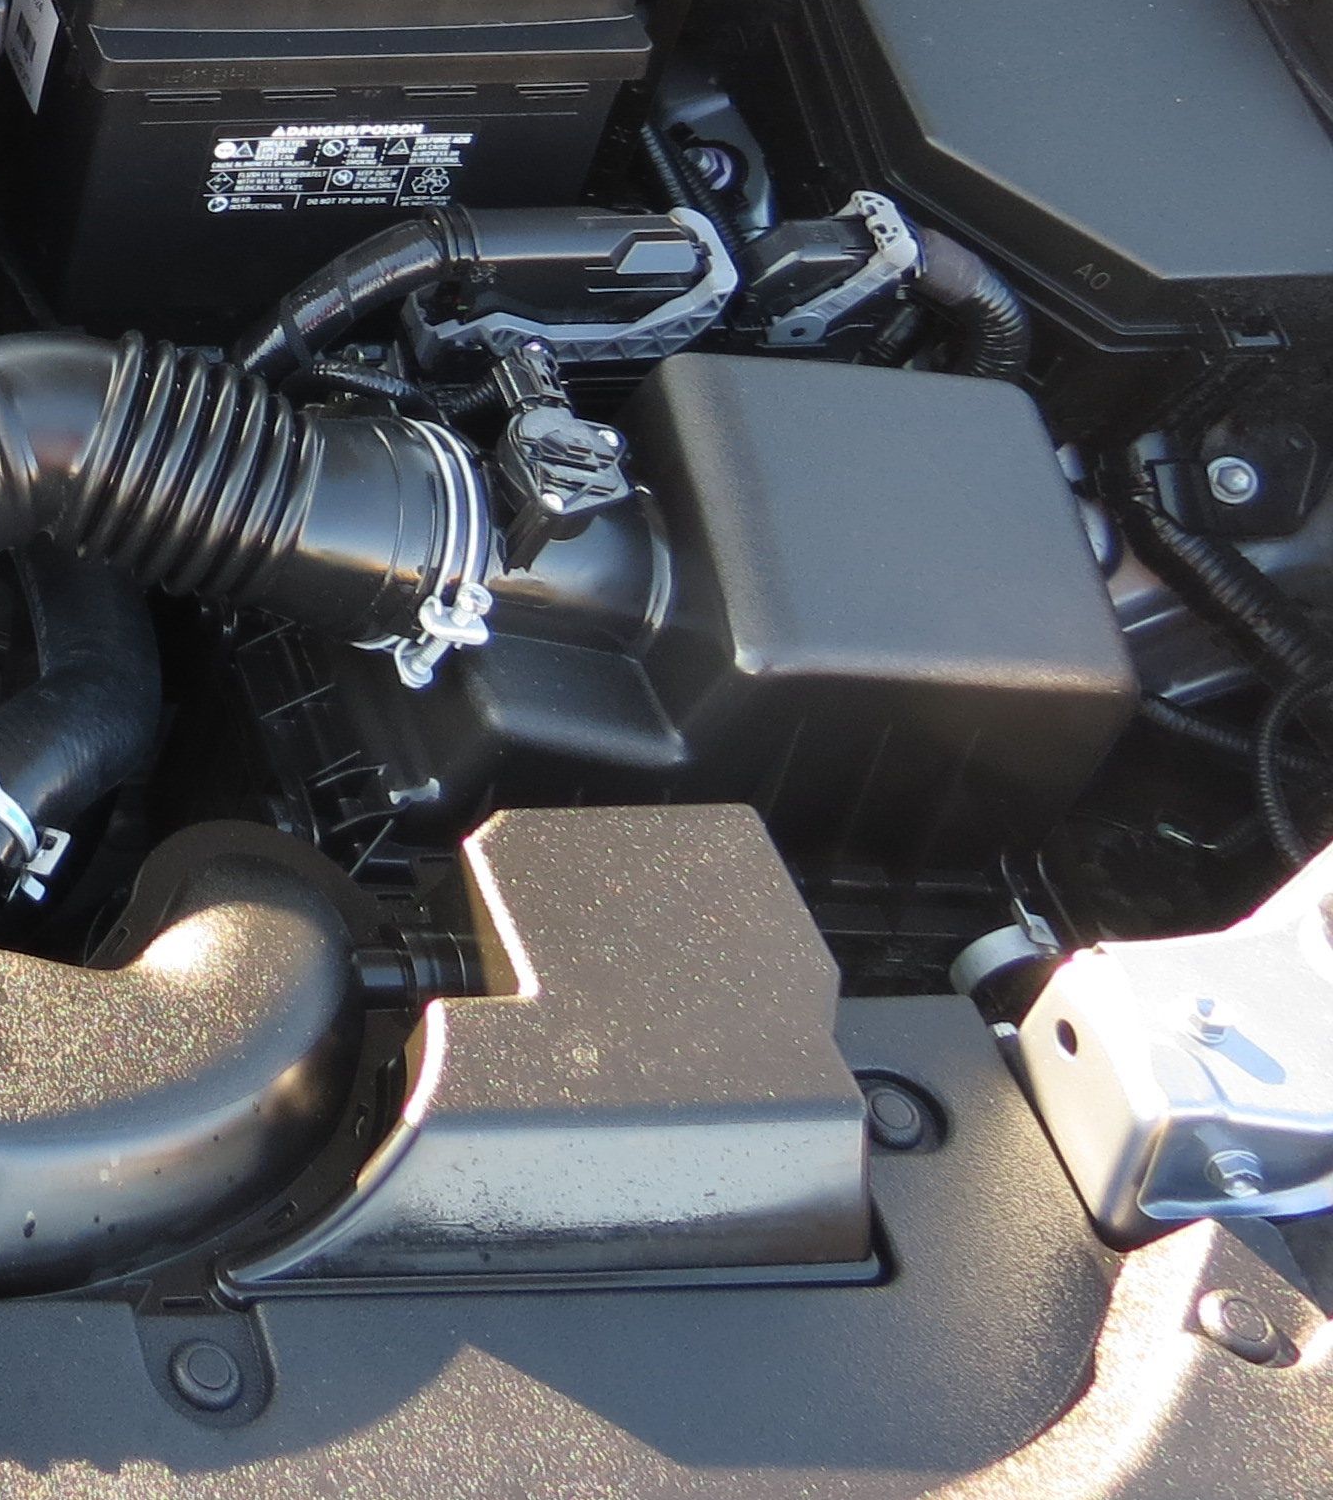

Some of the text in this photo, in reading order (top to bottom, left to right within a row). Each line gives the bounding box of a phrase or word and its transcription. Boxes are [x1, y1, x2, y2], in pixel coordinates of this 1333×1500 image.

[286, 123, 425, 137] DANGER/POISON
[452, 135, 472, 144] ACID
[306, 198, 318, 206] DO
[319, 197, 336, 205] NOT
